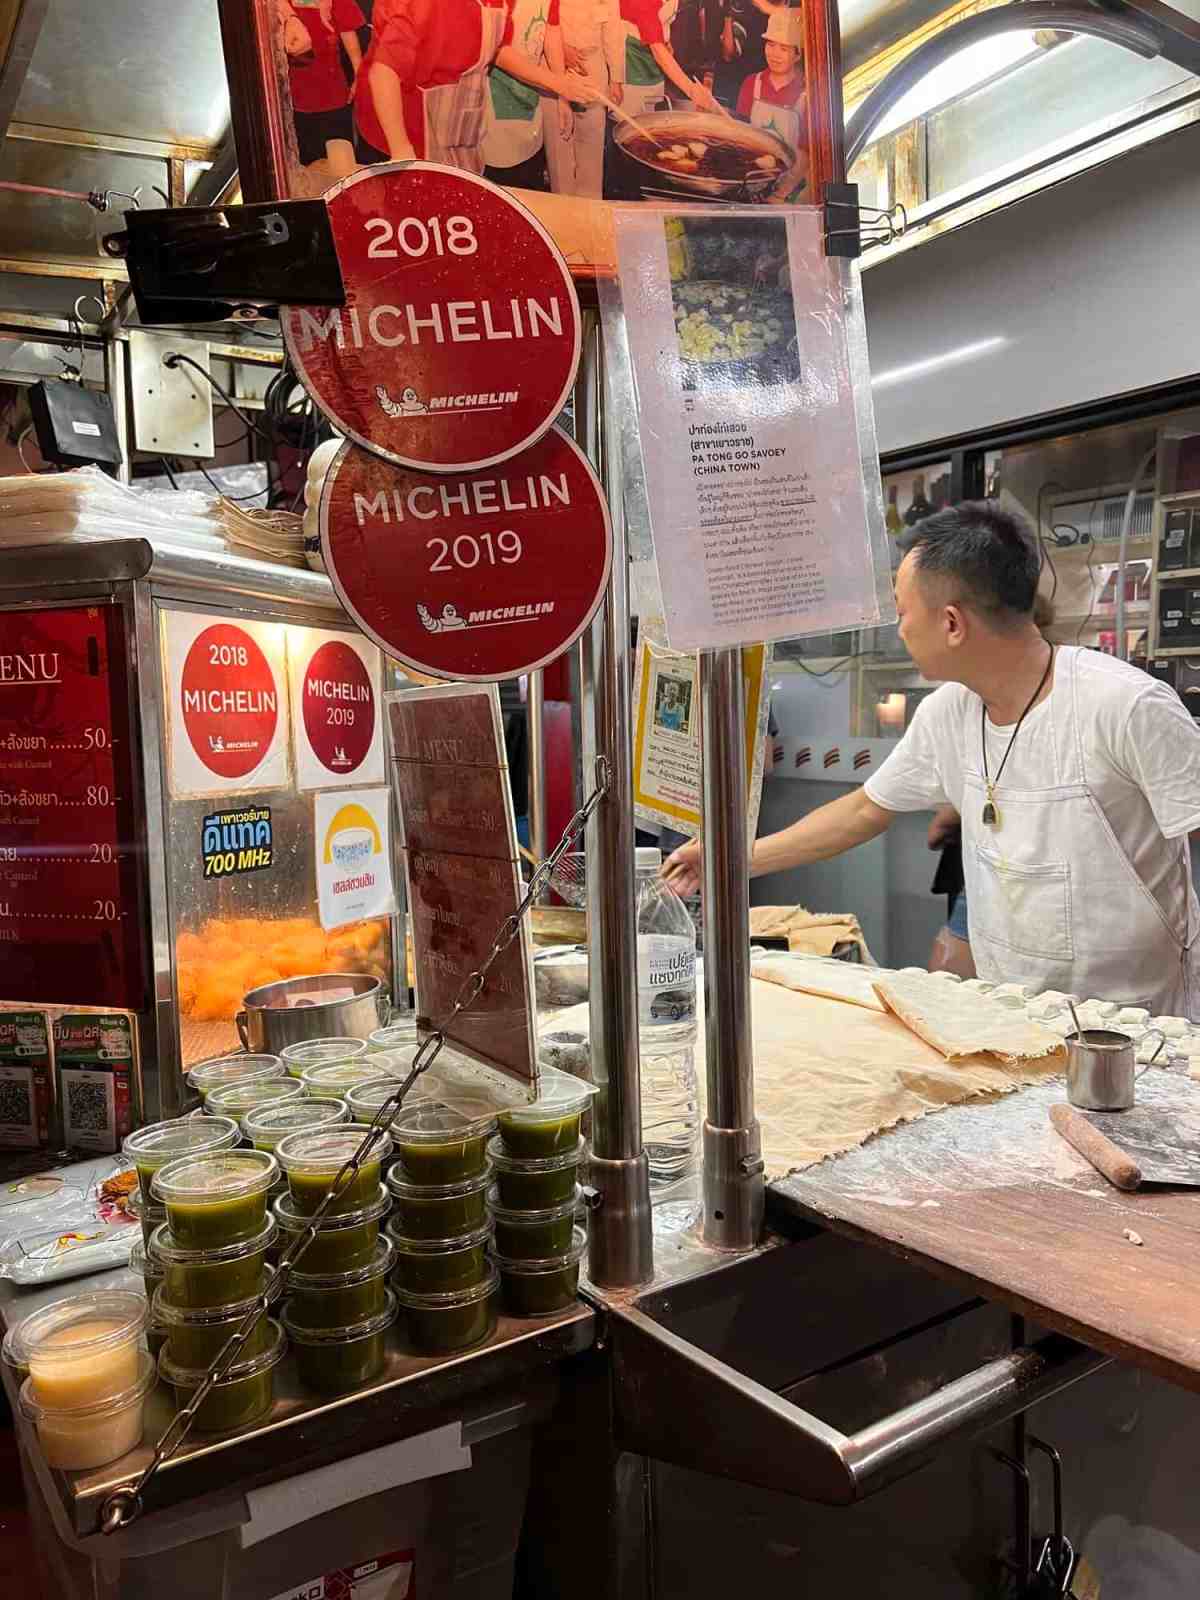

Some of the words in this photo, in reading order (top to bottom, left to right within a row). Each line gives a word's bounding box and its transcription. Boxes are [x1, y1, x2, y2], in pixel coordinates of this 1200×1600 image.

[364, 215, 478, 259] 2018
[299, 296, 564, 350] MICHELIN
[430, 391, 519, 409] MICHELIN
[691, 454, 705, 464] PA
[707, 451, 733, 462] TONG
[735, 450, 749, 460] GO
[751, 447, 786, 459] SAVOEY
[694, 464, 727, 476] (CHINA
[728, 462, 760, 474] TOWN)
[353, 473, 571, 526] MICHELIN
[426, 530, 522, 573] 2019
[469, 600, 555, 623] MICHELIN
[208, 644, 248, 666] 2018
[184, 690, 276, 713] MICHELIN
[307, 678, 370, 702] MICHELIN
[326, 707, 354, 726] 2019
[204, 815, 271, 854] ดีแทค
[205, 852, 236, 876] 700
[237, 847, 271, 870] MHz
